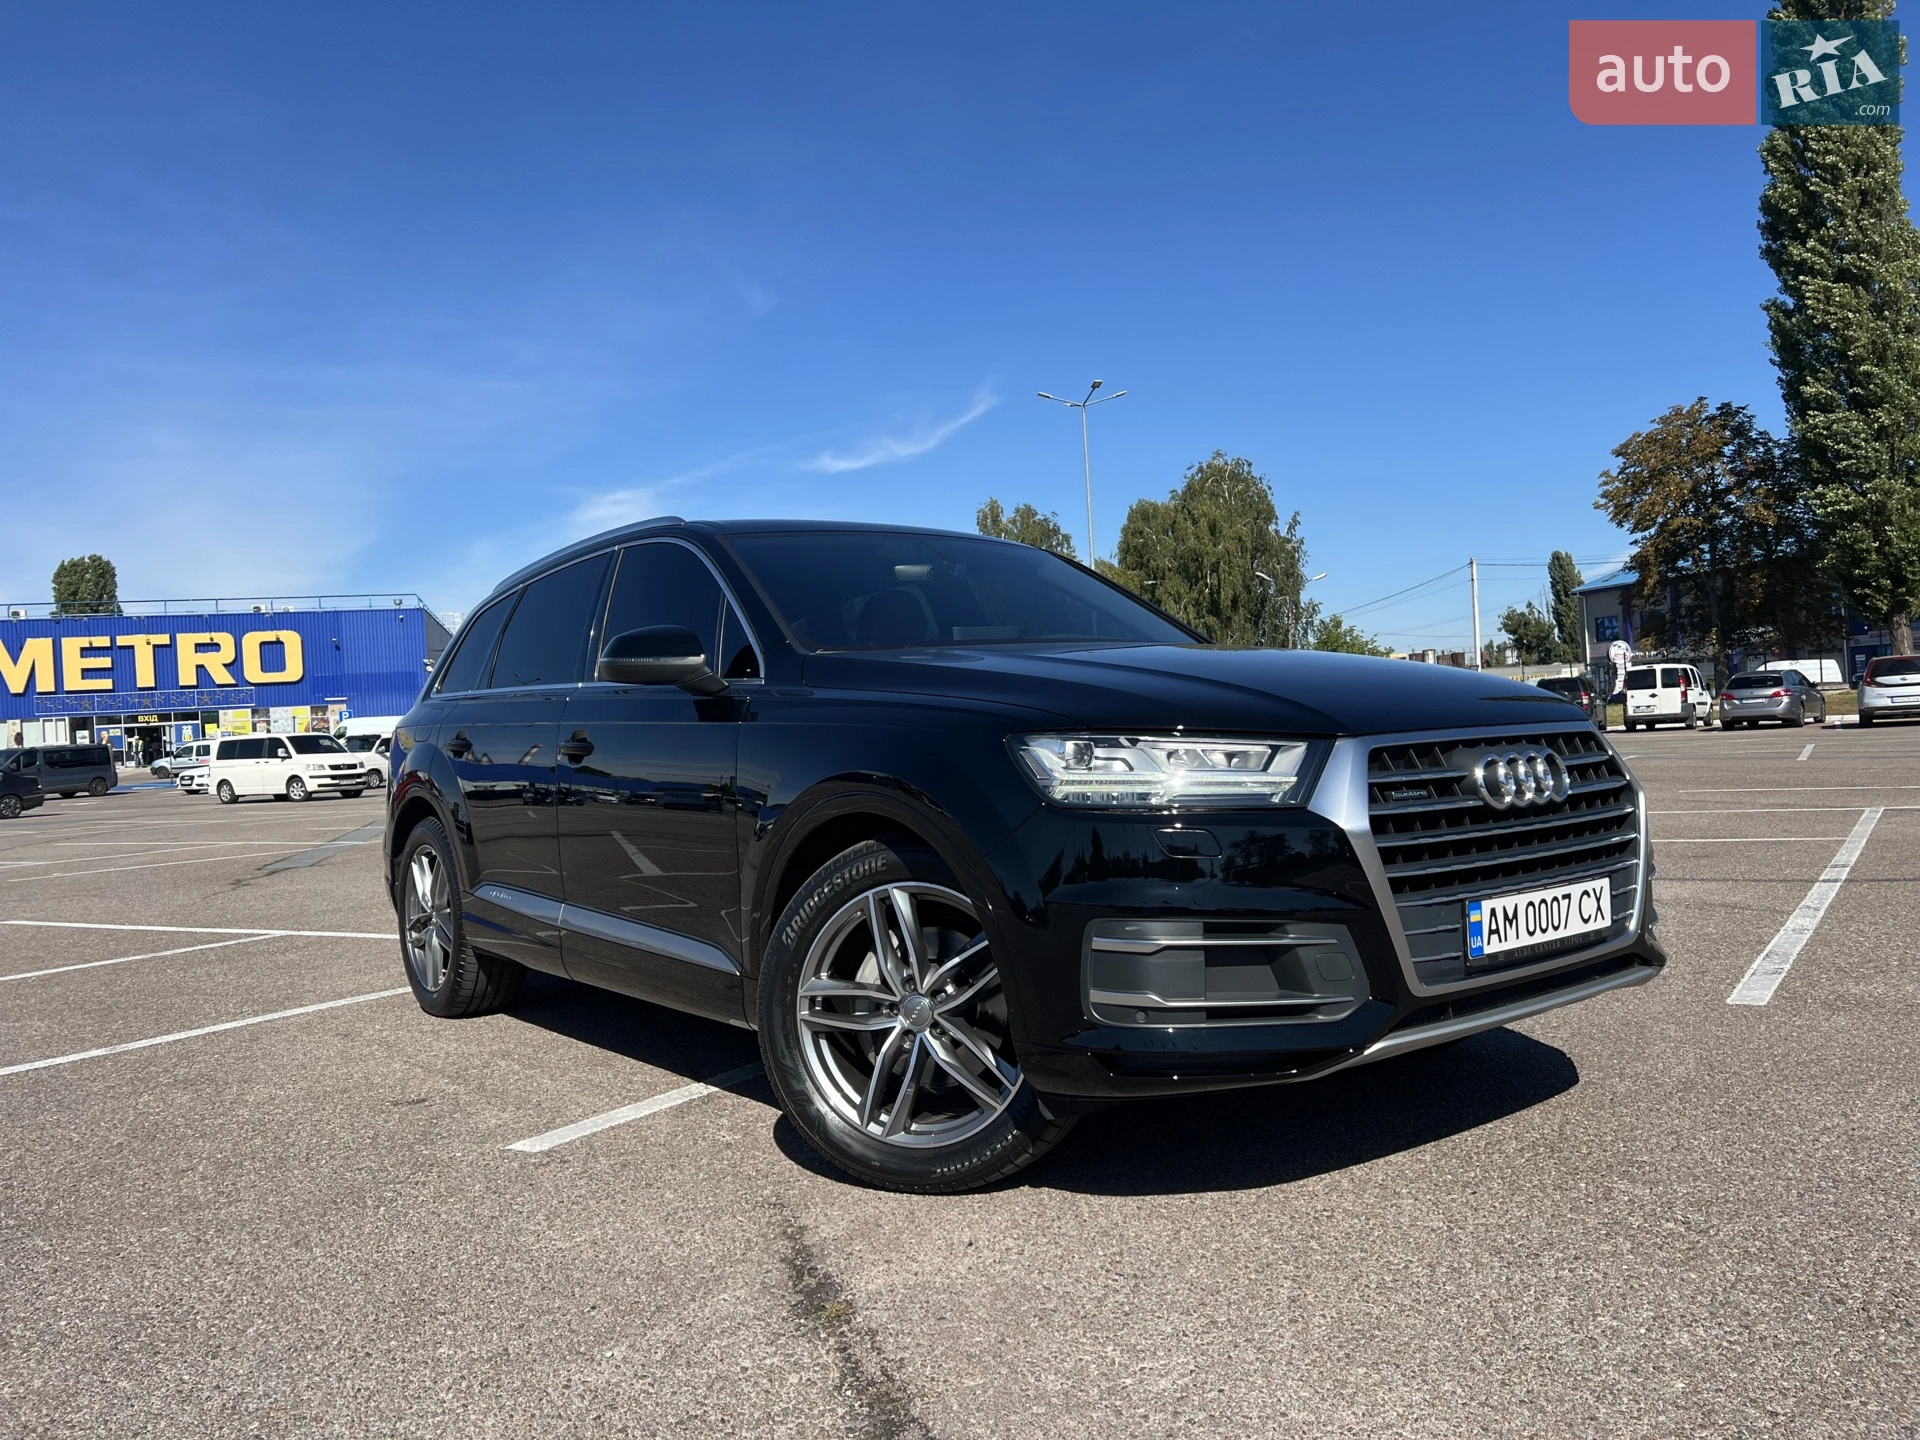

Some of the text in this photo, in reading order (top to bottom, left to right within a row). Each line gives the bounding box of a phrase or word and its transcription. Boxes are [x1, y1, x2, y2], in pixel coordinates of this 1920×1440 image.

[0, 630, 304, 695] METRO
[137, 714, 158, 723] ВХІД
[781, 852, 888, 952] BRIDGESTONE
[1486, 885, 1606, 946] AM 0007 CX
[1470, 935, 1483, 949] UA
[1513, 947, 1532, 958] AUDI
[1535, 940, 1560, 953] CENTER
